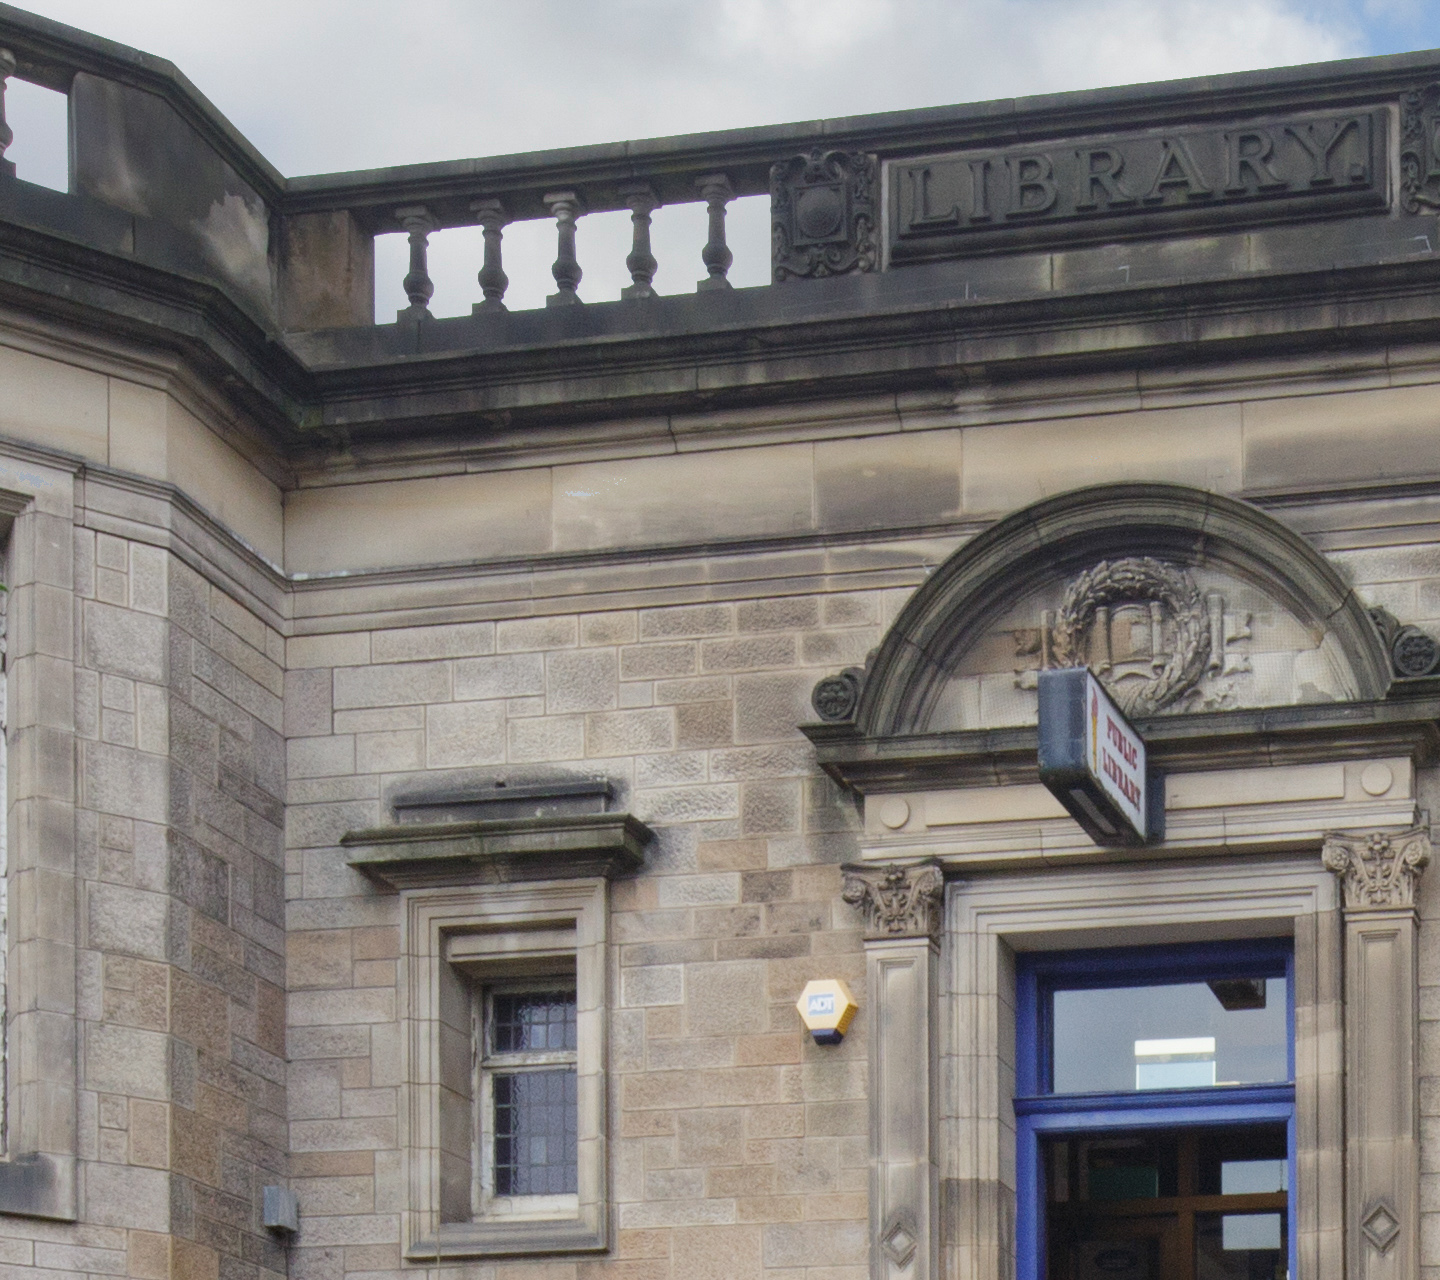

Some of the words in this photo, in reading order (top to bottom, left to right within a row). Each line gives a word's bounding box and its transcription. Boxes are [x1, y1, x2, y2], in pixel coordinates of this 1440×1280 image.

[1108, 716, 1137, 770] PUBLIC
[1103, 747, 1140, 812] LIBRARY
[809, 997, 834, 1011] ADT
